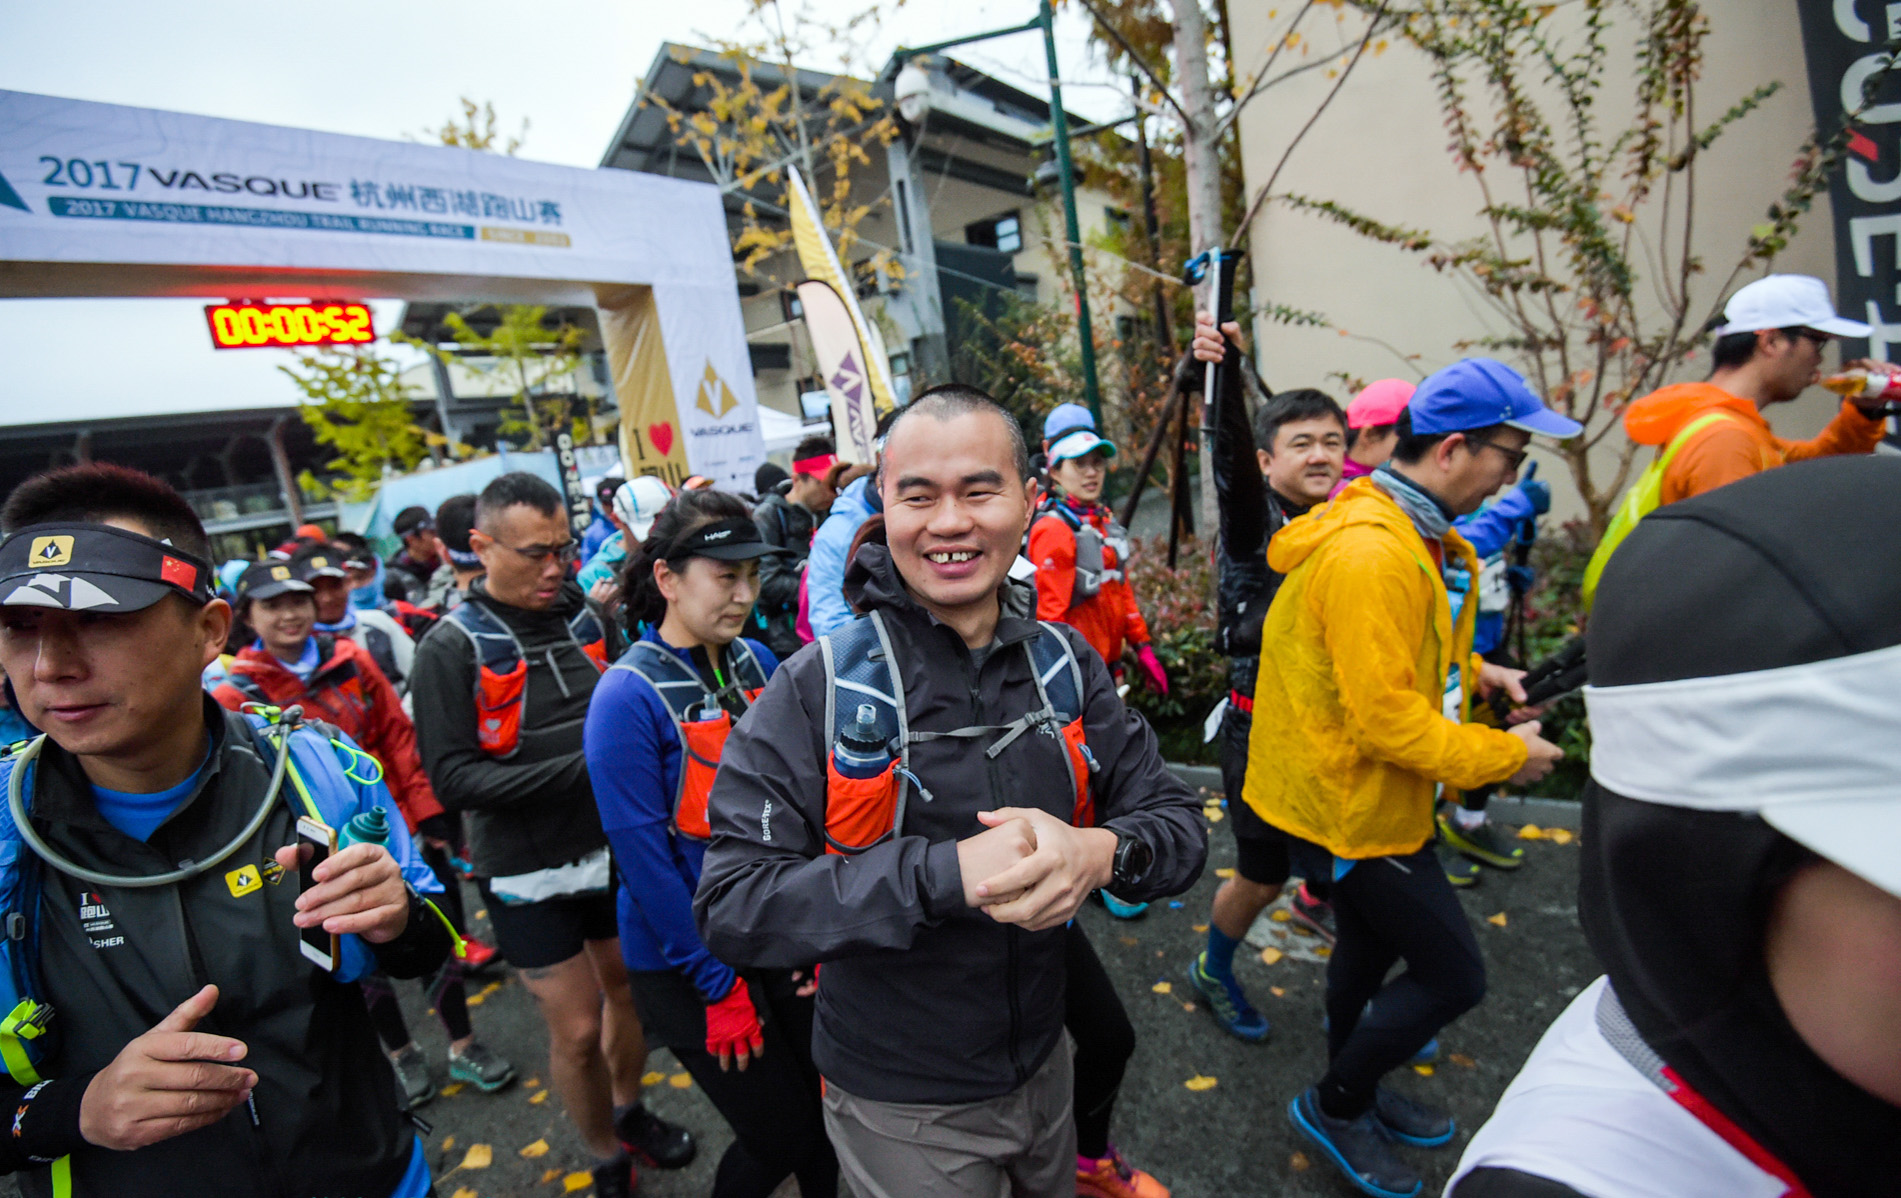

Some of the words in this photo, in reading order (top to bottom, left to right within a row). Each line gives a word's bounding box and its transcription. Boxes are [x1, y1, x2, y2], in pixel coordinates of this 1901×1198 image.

[38, 155, 141, 191] 2017
[149, 167, 342, 201] VASQUE
[350, 178, 563, 226] 杭州西湖跑山赛
[65, 200, 116, 217] 2017
[121, 203, 200, 222] VASQUE
[212, 305, 373, 346] 00:00:52
[689, 422, 755, 438] VASQUE
